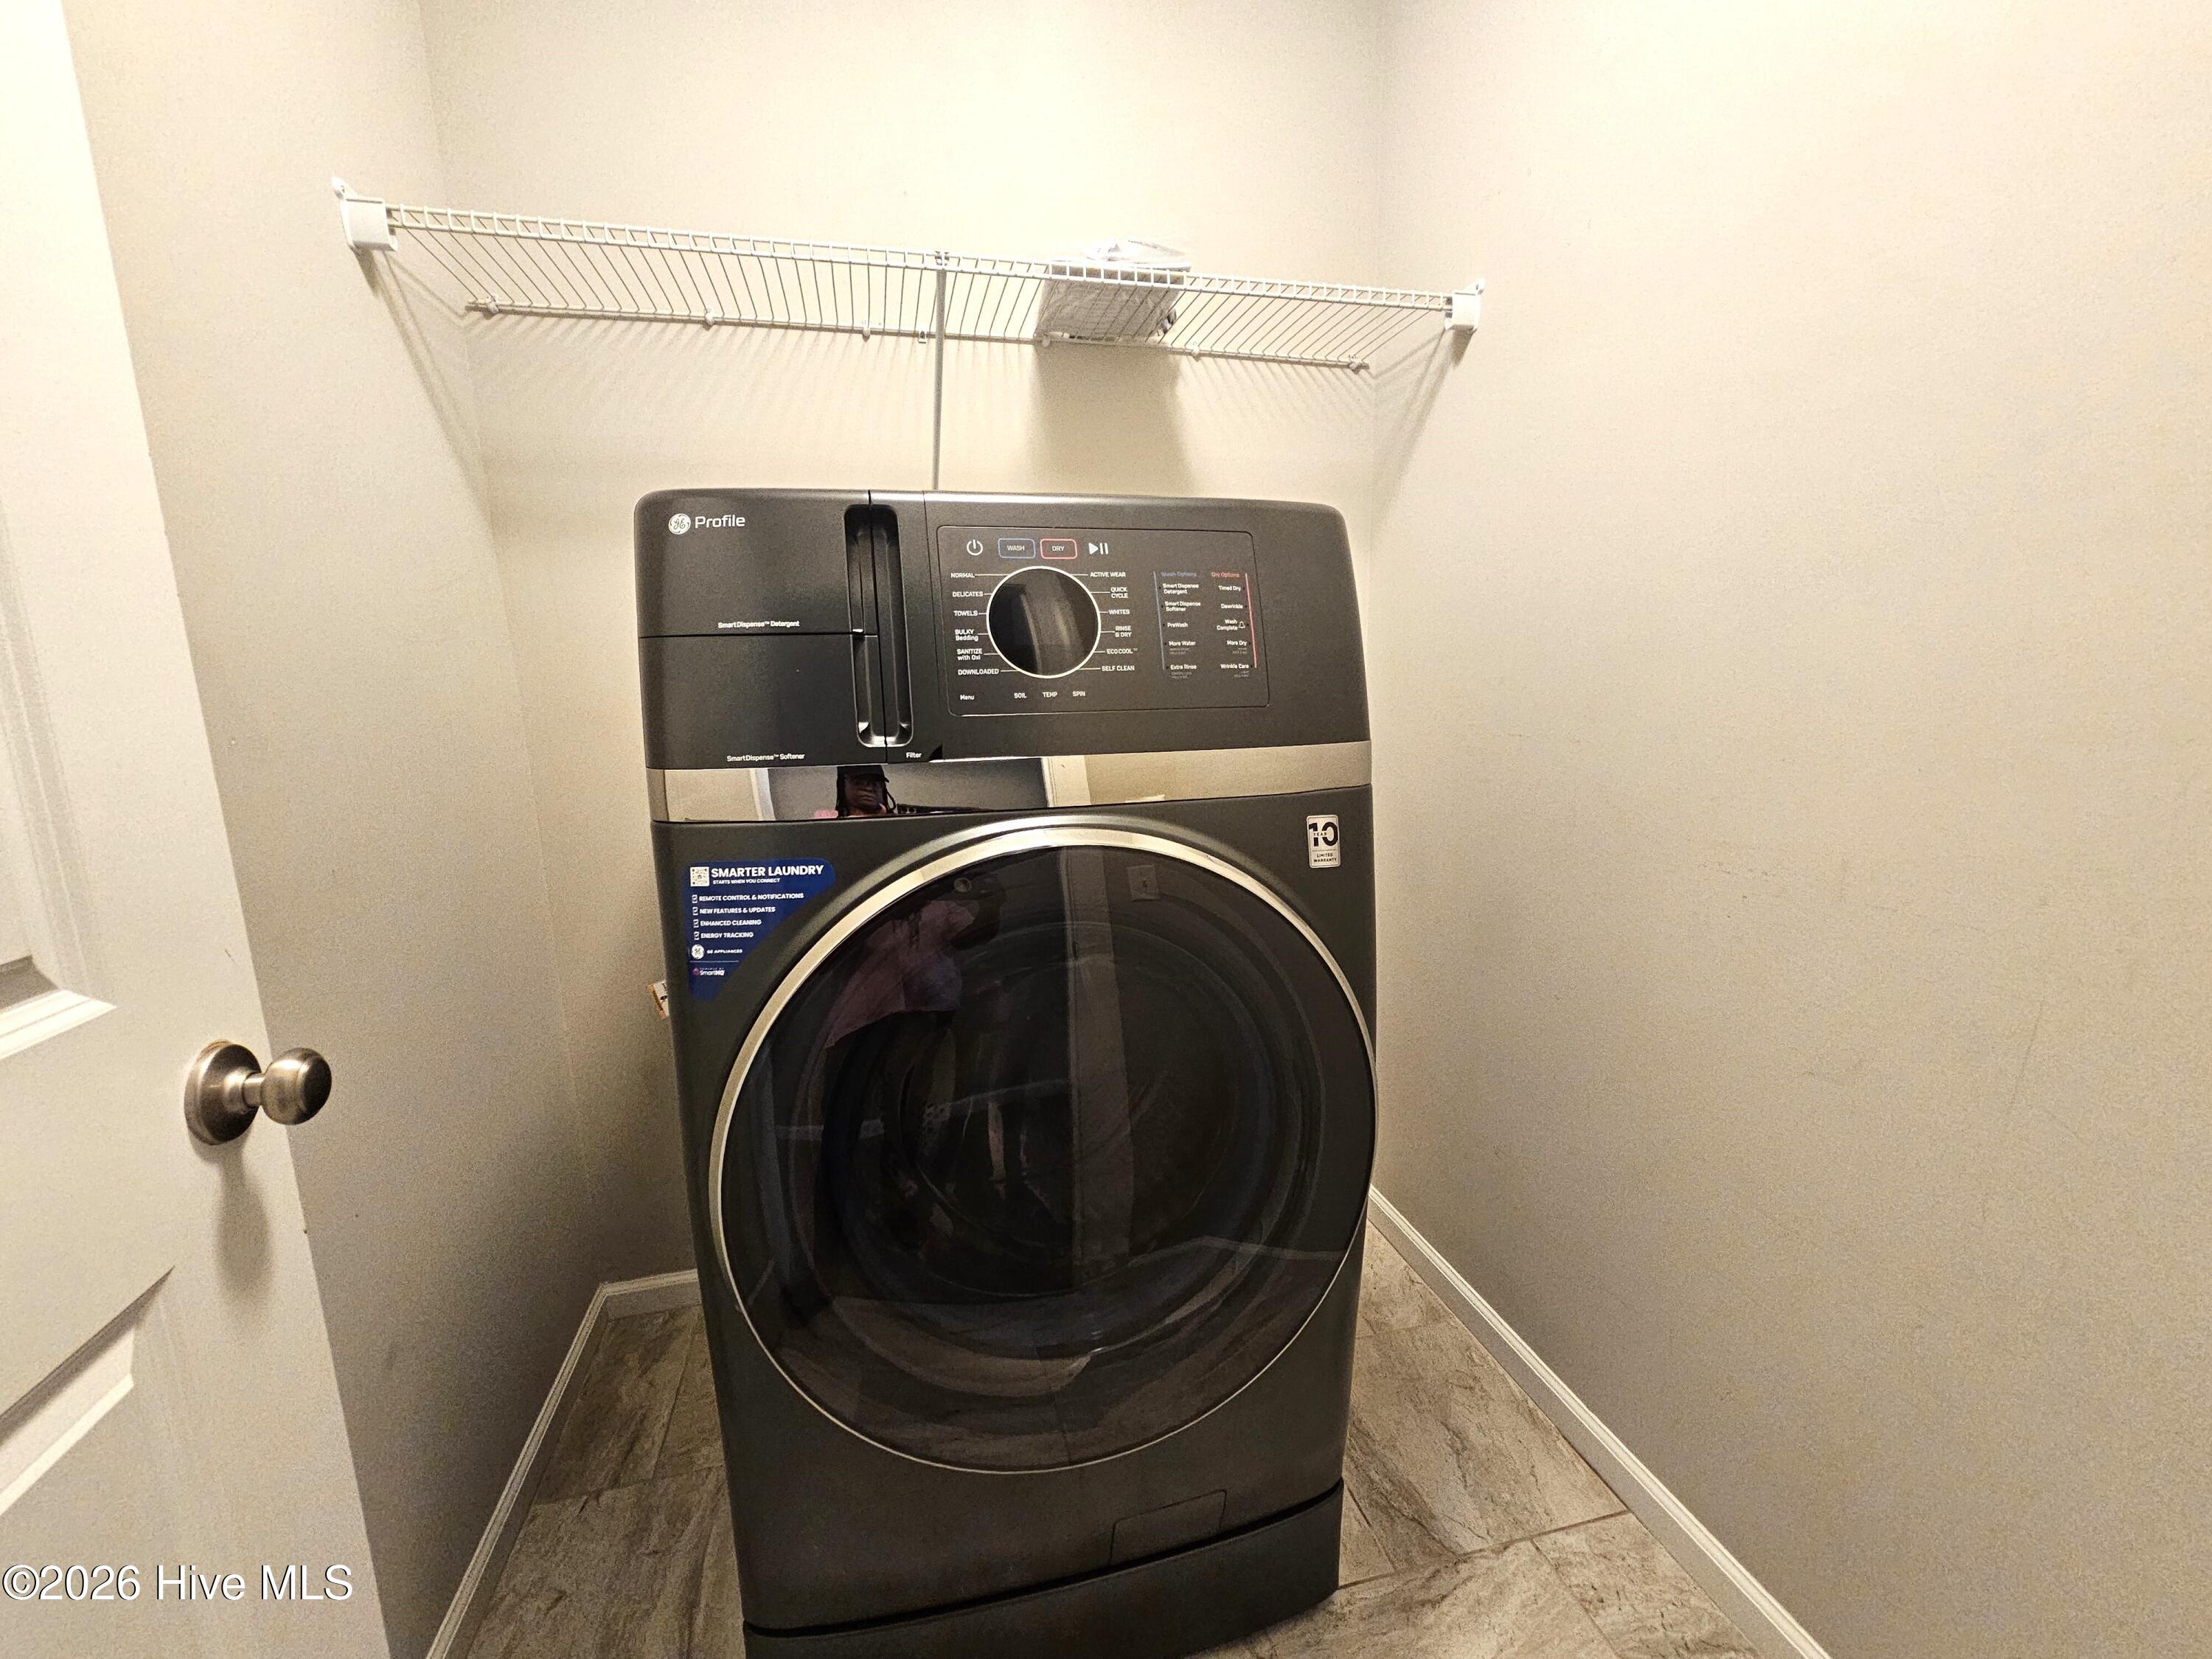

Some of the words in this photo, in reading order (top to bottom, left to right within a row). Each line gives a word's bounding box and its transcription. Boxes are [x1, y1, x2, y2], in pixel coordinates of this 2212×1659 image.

[695, 514, 745, 529] Profile
[1308, 821, 1339, 847] 10
[711, 866, 766, 877] SMARTER
[768, 865, 824, 876] LAUNDRY
